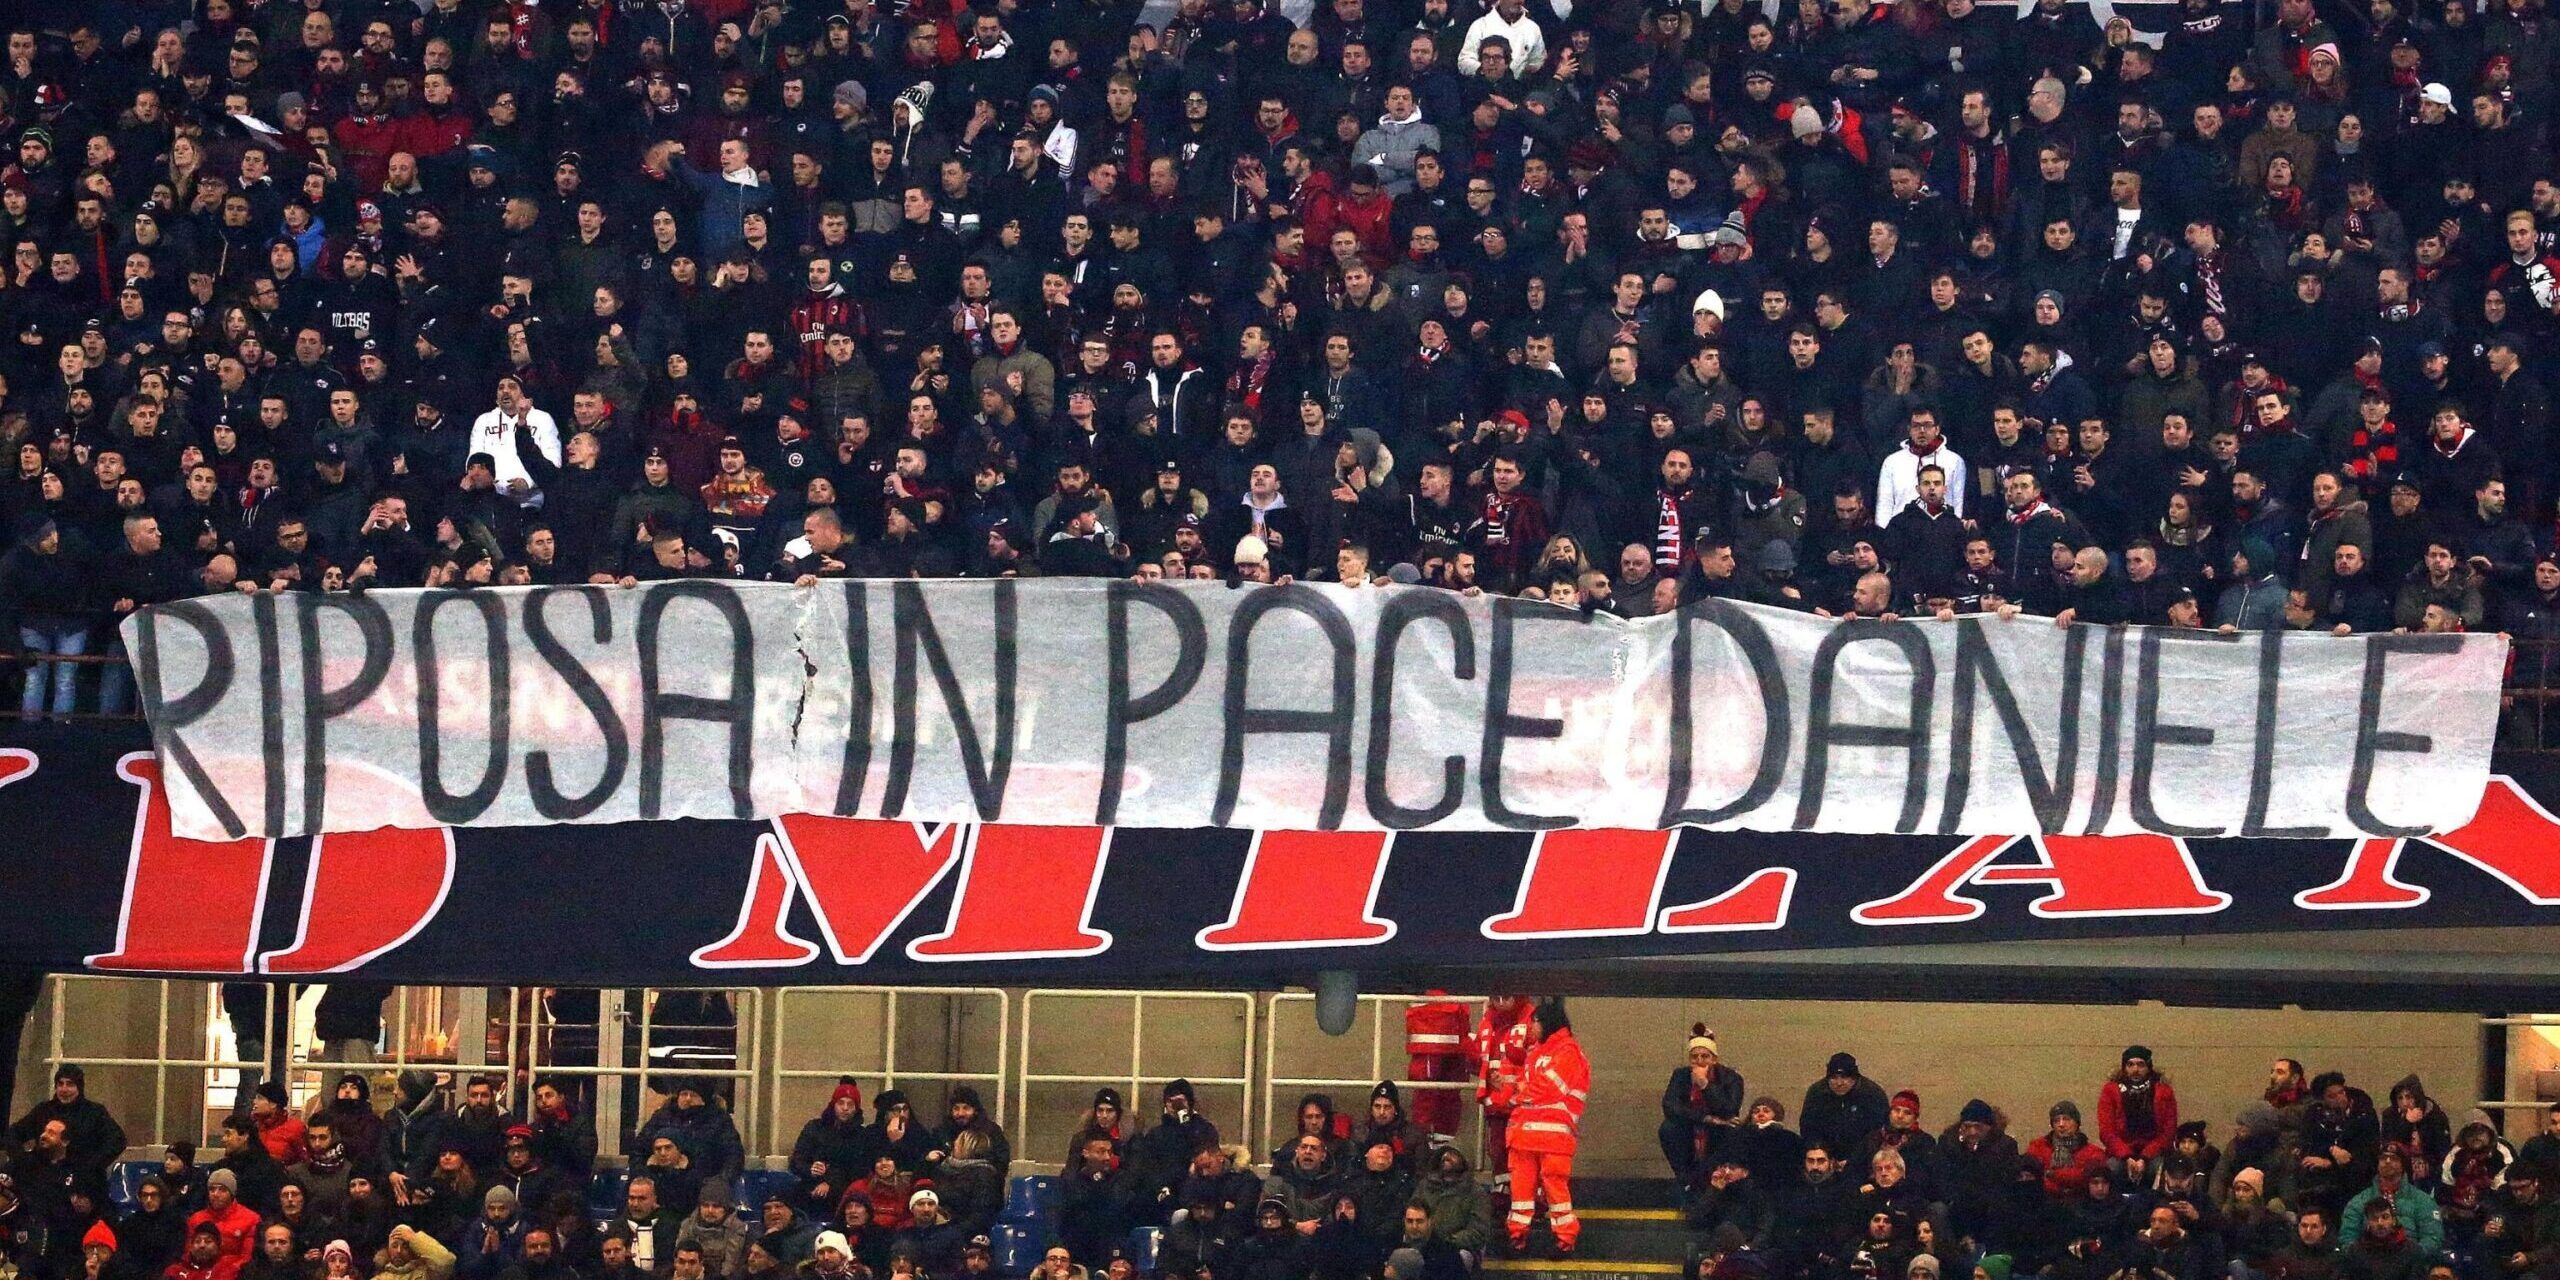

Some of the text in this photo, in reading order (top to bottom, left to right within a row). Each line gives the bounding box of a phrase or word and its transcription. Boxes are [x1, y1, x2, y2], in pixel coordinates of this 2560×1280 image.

[138, 577, 2462, 840] RIPOSA IN PACE DANIELE
